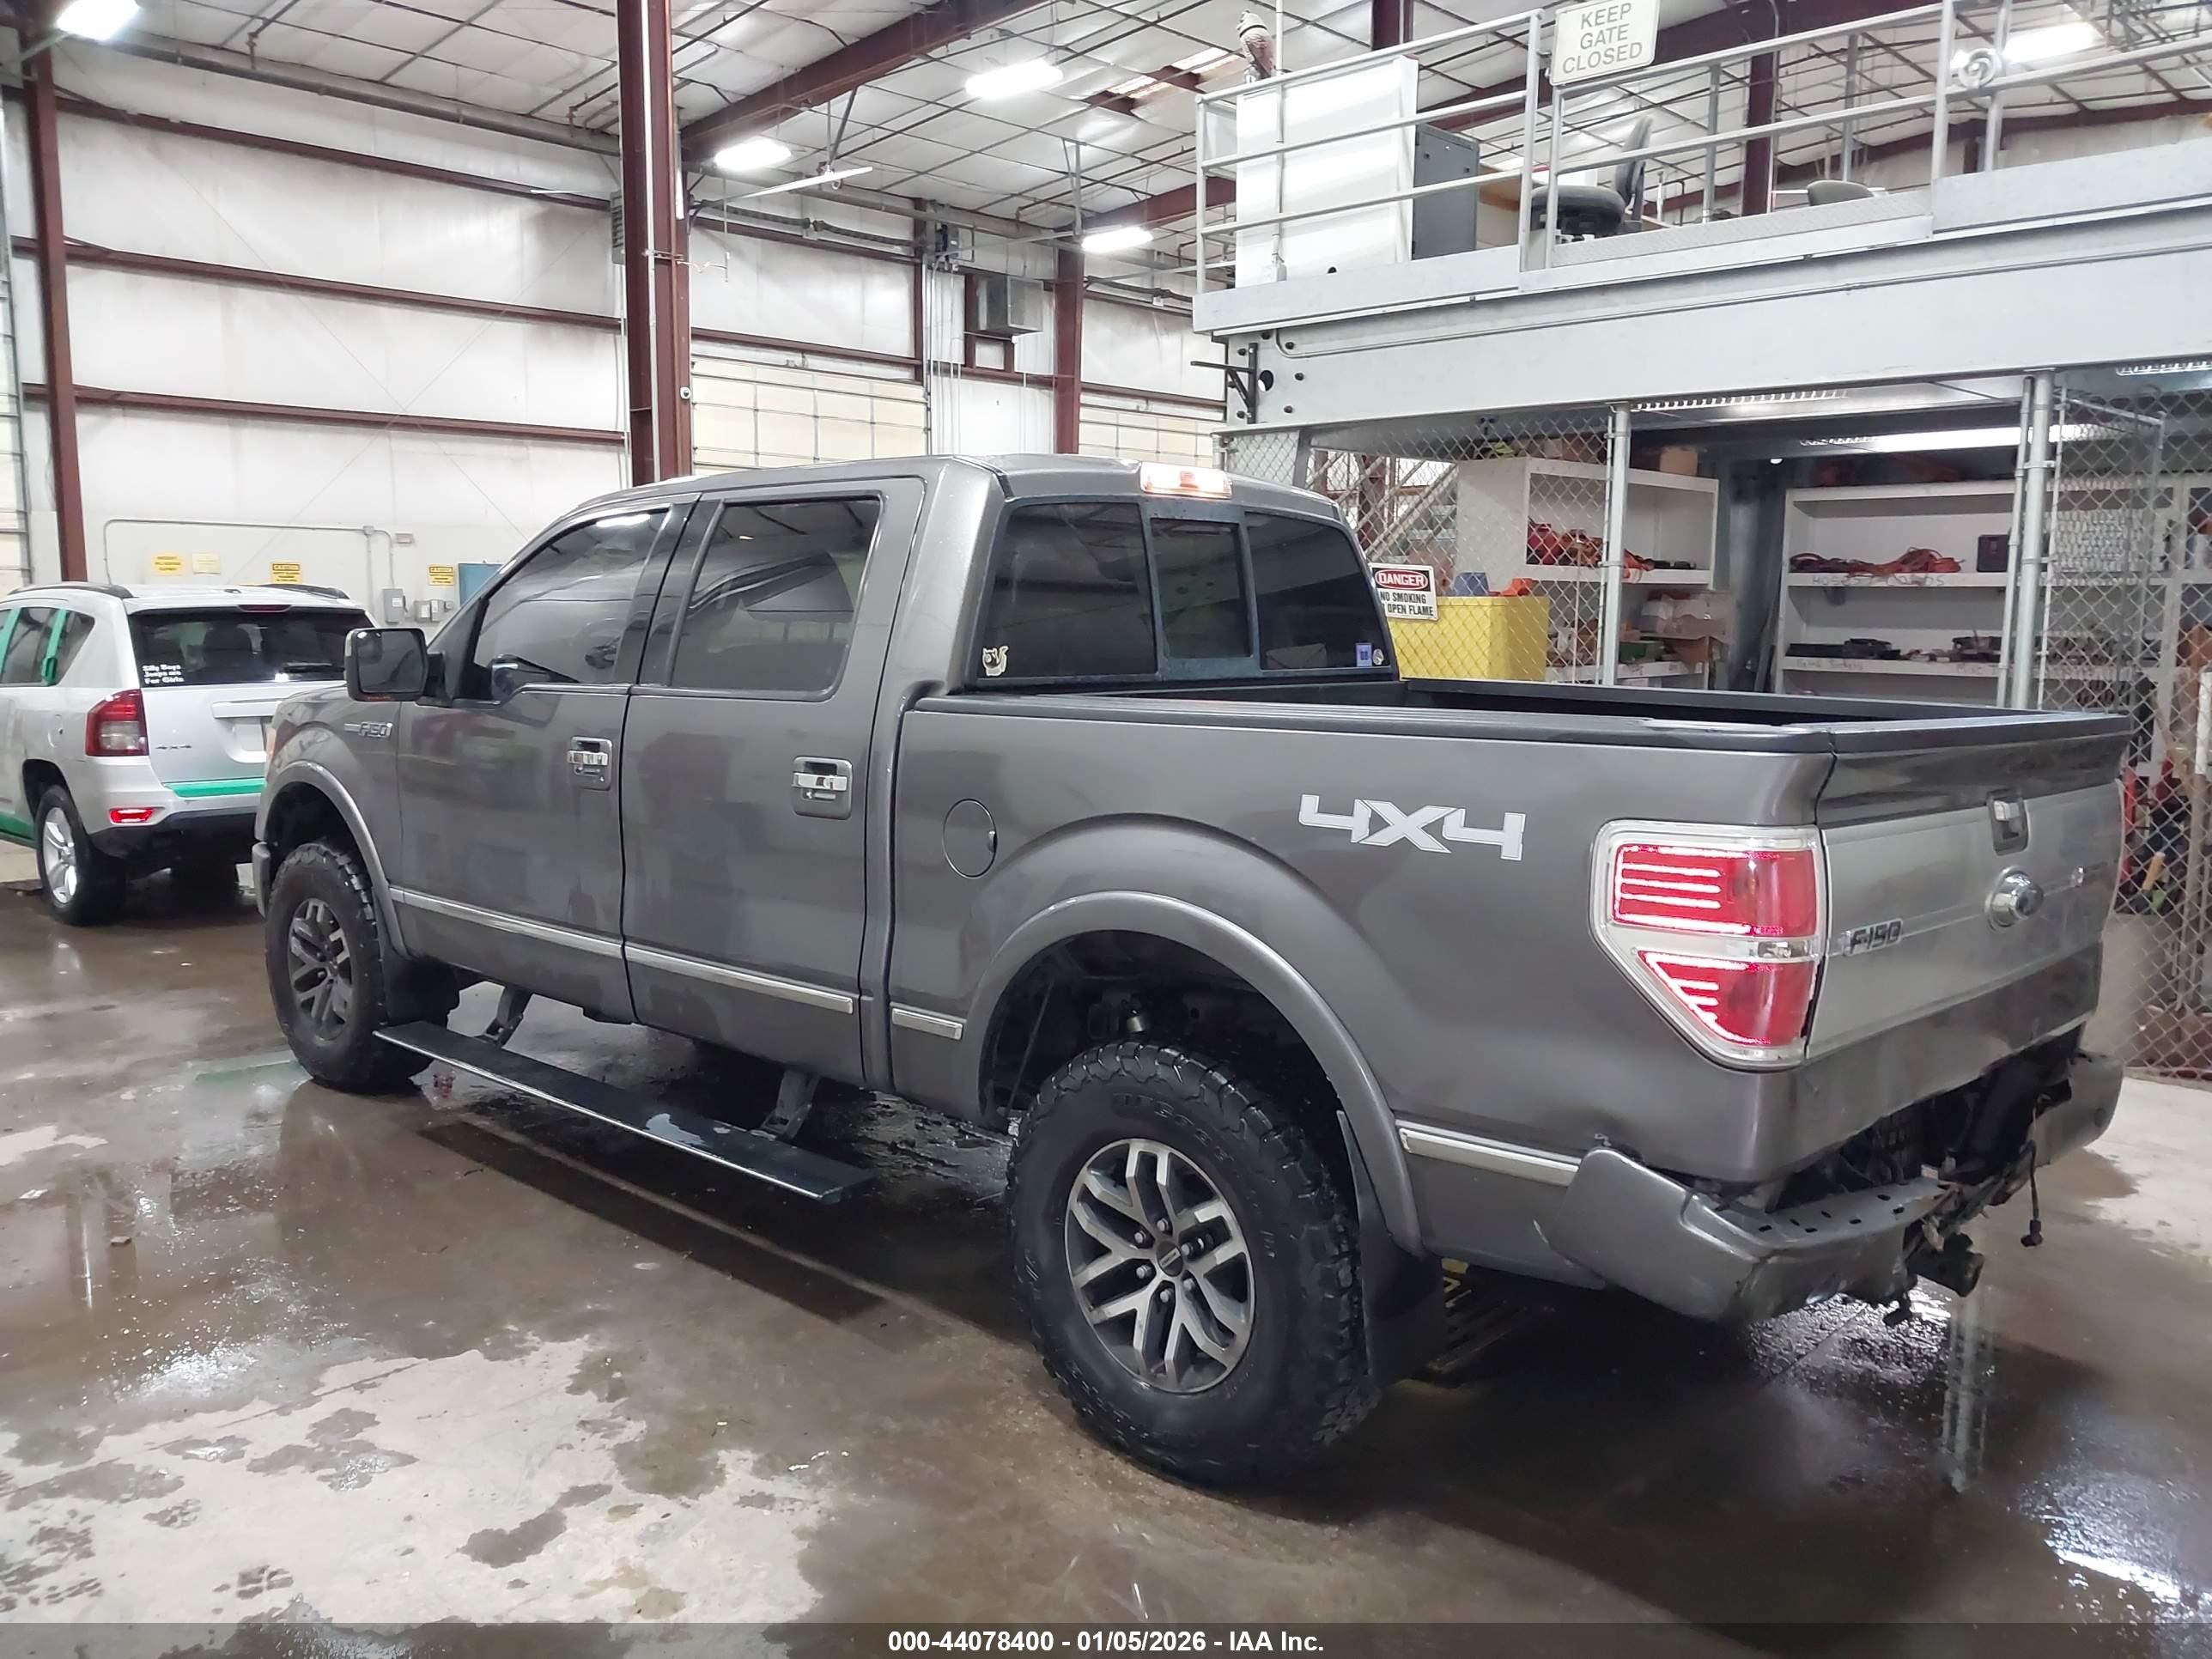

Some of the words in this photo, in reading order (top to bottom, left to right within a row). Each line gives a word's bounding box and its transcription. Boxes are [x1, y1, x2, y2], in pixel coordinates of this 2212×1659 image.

[1581, 3, 1632, 29] KEEP
[1580, 23, 1629, 50] GATE
[1563, 41, 1643, 74] CLOSED
[1378, 573, 1424, 586] DANGER
[1380, 591, 1390, 601] NO
[1392, 592, 1426, 604] SMOKING
[1387, 603, 1407, 615] OPEN
[1408, 605, 1434, 617] FLAME
[1848, 919, 1903, 955] F-150
